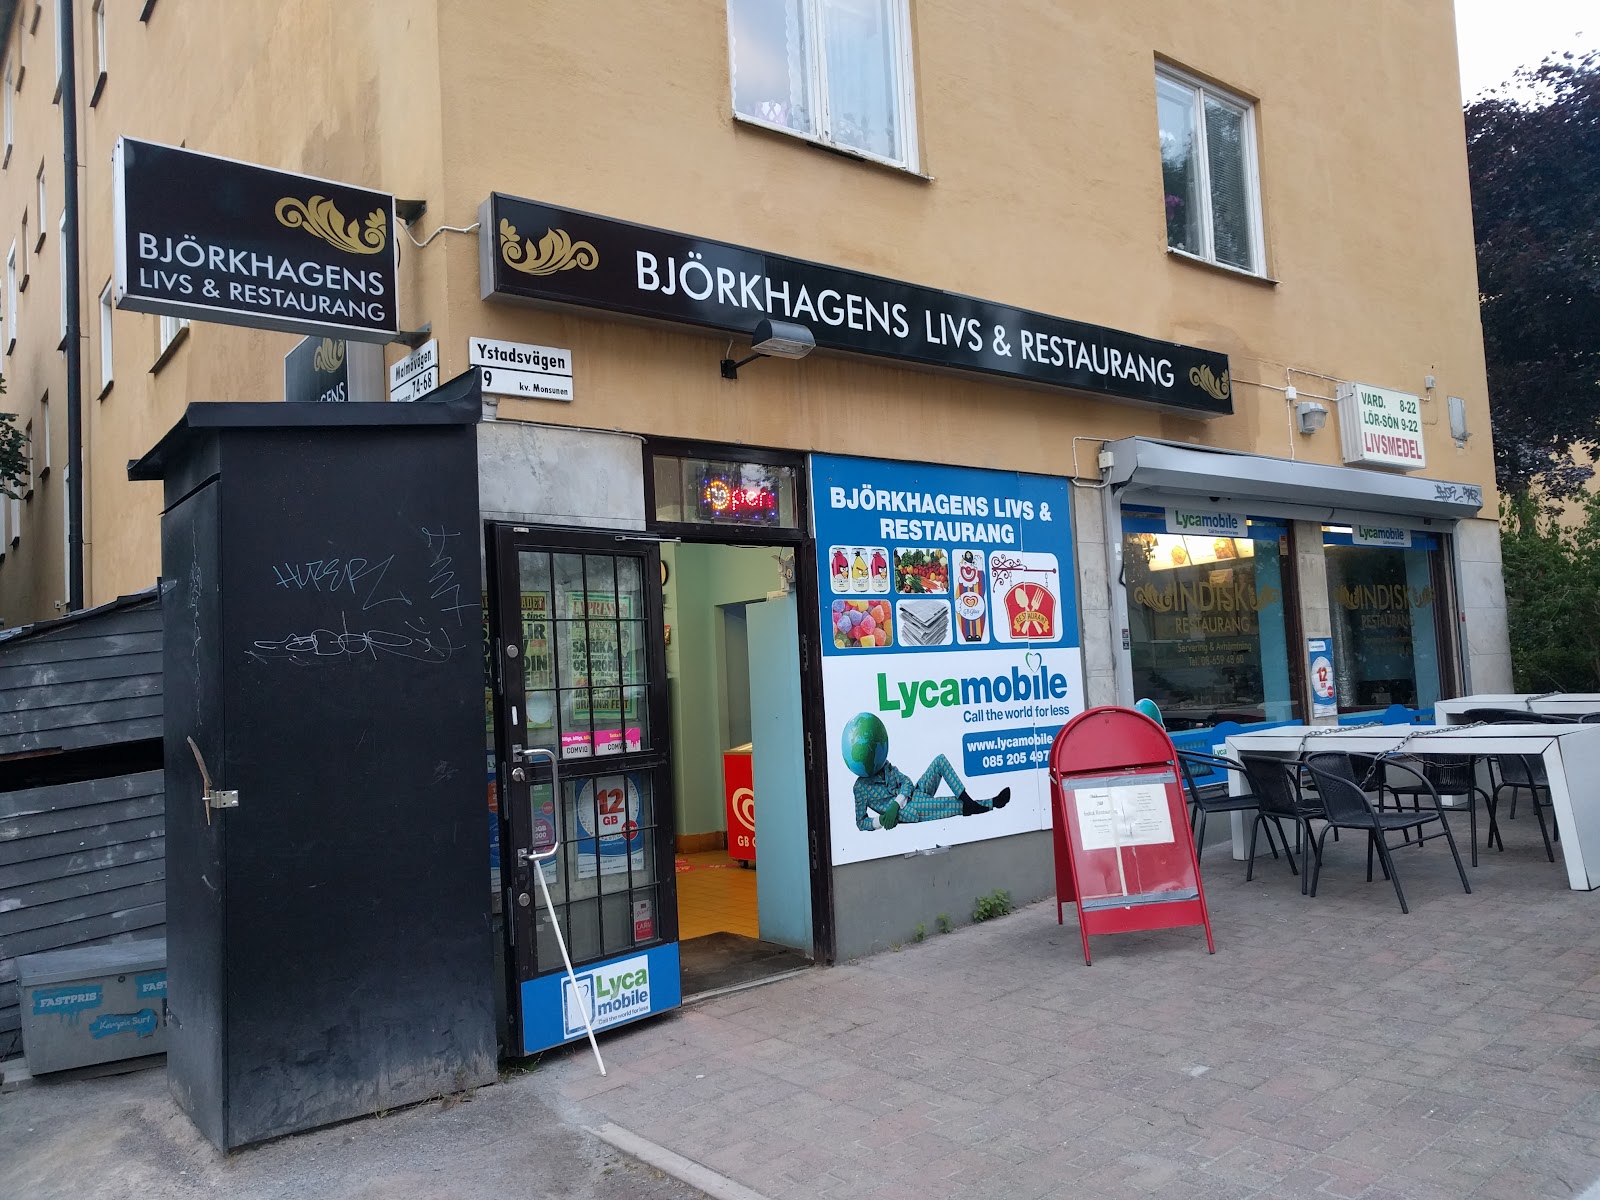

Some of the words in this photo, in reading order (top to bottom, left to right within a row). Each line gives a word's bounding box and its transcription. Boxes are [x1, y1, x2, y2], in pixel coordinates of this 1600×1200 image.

[139, 233, 384, 296] BJÖRKHAGENS
[140, 268, 193, 295] LIVS
[202, 278, 221, 298] &
[229, 282, 386, 322] RESTAURANG
[636, 250, 910, 339] BJÖRKHAGENS
[925, 310, 983, 352] LIVS
[992, 325, 1012, 357] &
[1020, 329, 1175, 388] RESTAURANG
[395, 350, 431, 381] Malmövägen
[476, 343, 566, 371] Ystadsvägen
[412, 371, 432, 398] 74-68
[483, 370, 493, 387] 9
[519, 382, 531, 391] kv.
[532, 384, 568, 395] Monsunen
[1361, 391, 1386, 408] VARD.
[1399, 400, 1416, 414] 8-22
[1363, 410, 1399, 430] LÖR-SÖN
[1401, 419, 1419, 432] 9-22
[1364, 432, 1422, 459] LIVSMEDEL
[830, 483, 989, 517] BJÖRKHAGENS
[994, 498, 1035, 521] LIVS
[1040, 502, 1052, 521] &
[880, 518, 1015, 544] RESTAURANG
[1175, 510, 1238, 529] Lycamobile
[1359, 525, 1404, 541] Lycamobile
[1173, 581, 1249, 612] INDISK
[1360, 584, 1410, 610] INDISK
[1176, 617, 1250, 634] RESTAURANG
[1210, 642, 1215, 651] &
[1317, 667, 1328, 682] 12
[877, 665, 1068, 719] Lycamobile
[963, 709, 984, 723] Call
[986, 709, 1003, 721] the
[1005, 705, 1032, 719] world
[1035, 705, 1049, 718] for
[1050, 704, 1070, 716] less
[982, 755, 1003, 768] 085
[1006, 752, 1027, 765] 205
[1029, 750, 1051, 762] 497
[597, 789, 624, 815] 12
[603, 816, 618, 826] GB
[738, 836, 750, 847] GB
[596, 968, 647, 1000] Lyca
[39, 992, 97, 1008] FASTPRIS
[597, 989, 648, 1016] mobile
[618, 1010, 631, 1019] world
